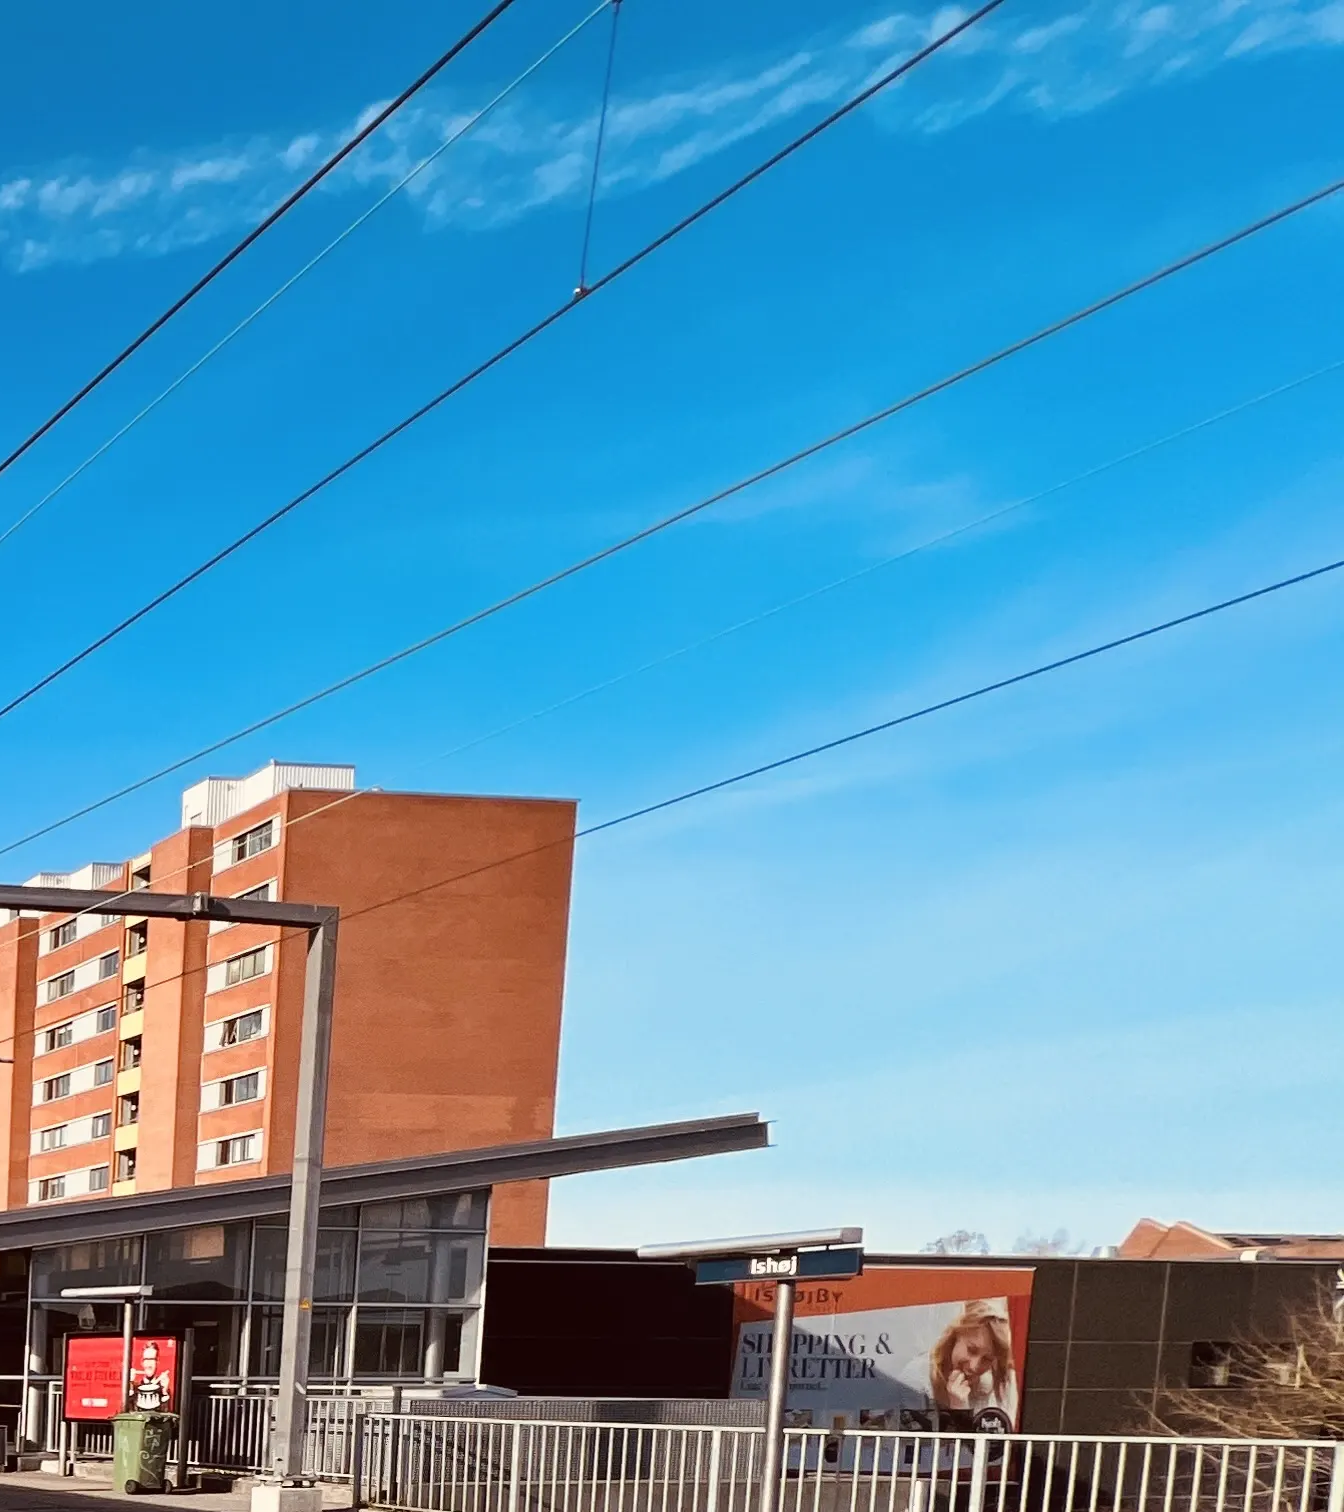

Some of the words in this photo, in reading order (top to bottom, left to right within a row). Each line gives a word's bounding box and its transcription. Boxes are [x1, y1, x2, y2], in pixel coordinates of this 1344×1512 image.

[750, 1256, 797, 1275] Ishøj
[742, 1333, 865, 1355] SHPPING
[875, 1332, 894, 1355] &
[741, 1357, 876, 1378] LIRETTER
